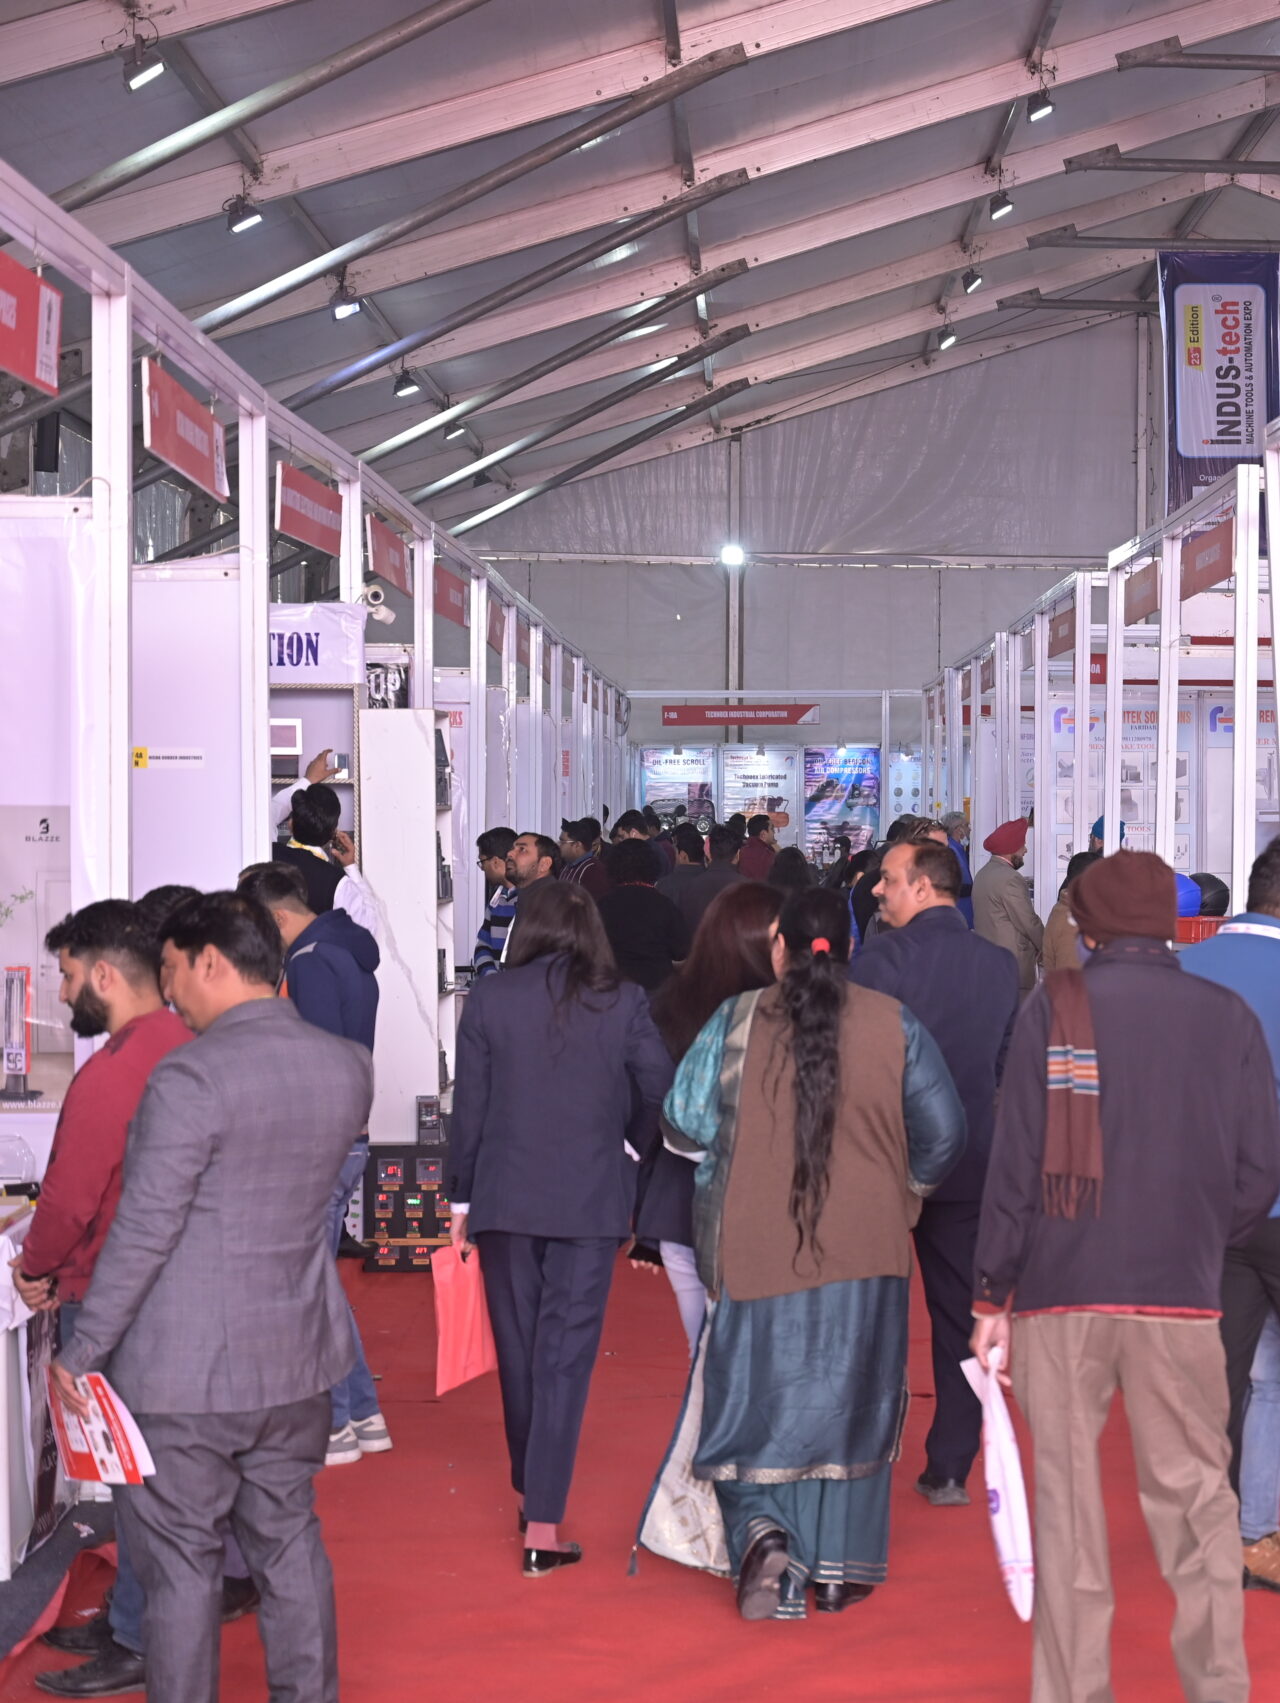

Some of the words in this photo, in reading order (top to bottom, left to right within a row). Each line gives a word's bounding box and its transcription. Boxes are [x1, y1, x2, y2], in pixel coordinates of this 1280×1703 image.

[1190, 305, 1200, 343] Edition
[1243, 300, 1252, 321] EXPO
[1243, 323, 1253, 372] AUTOMATION
[1244, 383, 1254, 408] TOOLS
[1245, 409, 1254, 445] MACHINE
